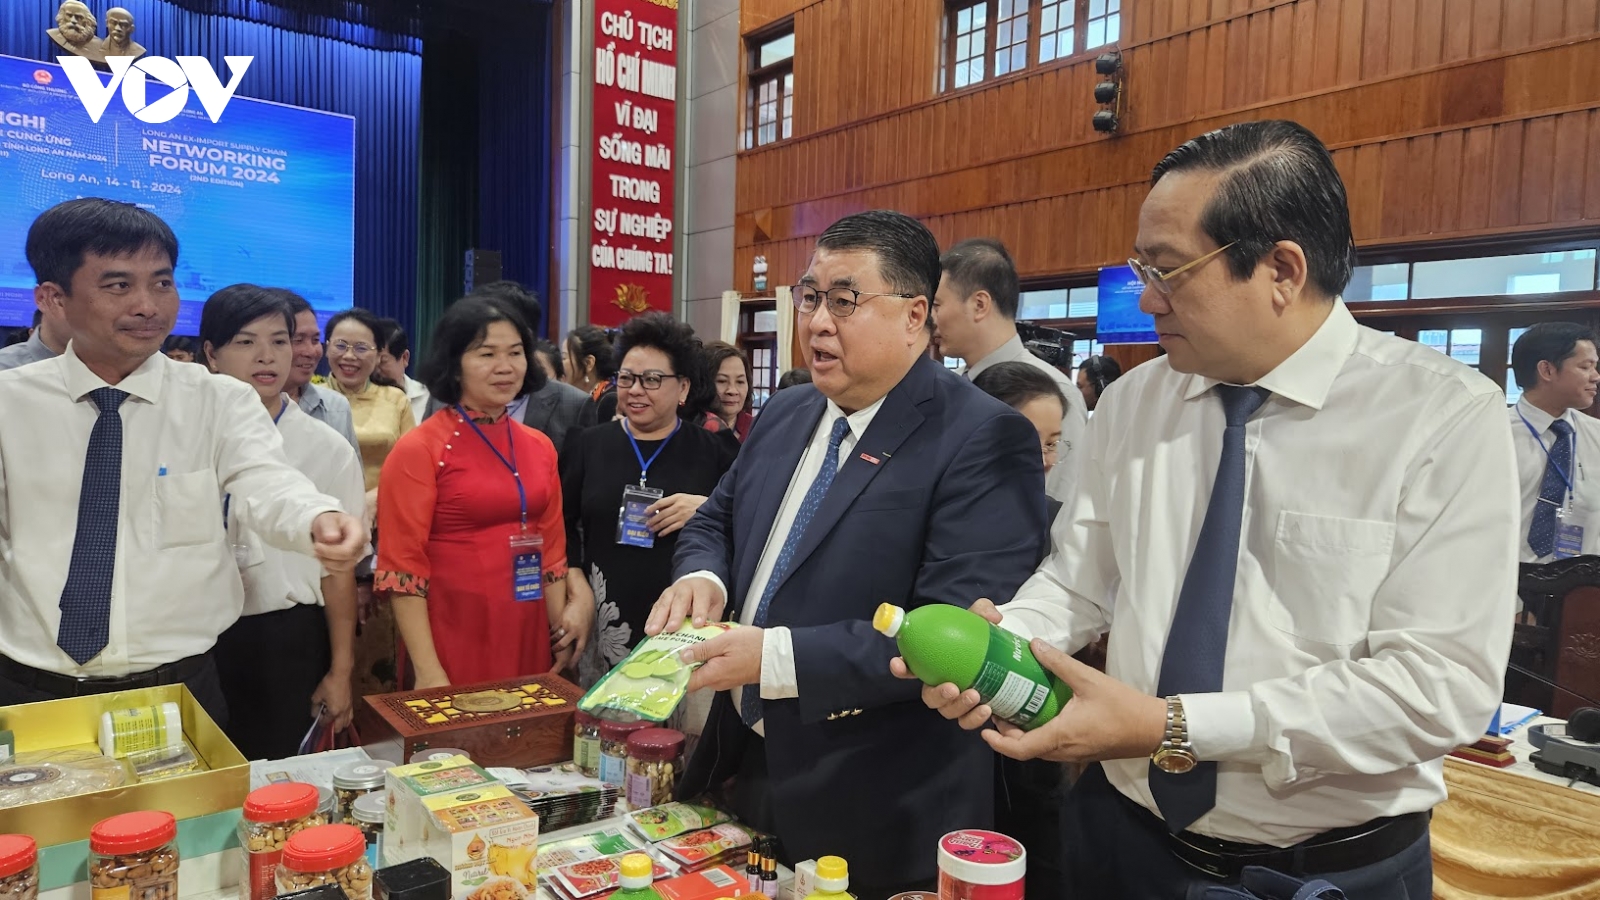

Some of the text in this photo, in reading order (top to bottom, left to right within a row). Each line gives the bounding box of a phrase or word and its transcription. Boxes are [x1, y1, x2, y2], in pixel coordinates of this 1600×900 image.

[601, 10, 673, 51] CHỦ TỊCH
[596, 41, 676, 101] HỒ CHÍ MINH
[614, 100, 658, 134] VĨ ĐẠI
[7, 130, 72, 147] CUNG ỨNG
[25, 145, 50, 154] LONG
[52, 148, 65, 156] AN
[87, 154, 108, 162] 2024
[142, 128, 287, 156] LONG AN EX-IMPORT SUPPLY CHAIN
[142, 137, 286, 170] NETWORKING
[599, 132, 671, 170] SỐNG MÃI
[42, 168, 75, 183] Long
[78, 173, 100, 186] An,
[105, 176, 120, 187] 14
[130, 179, 141, 188] 11
[151, 181, 182, 194] 2024
[149, 154, 280, 184] FORUM 2024
[609, 174, 661, 204] TRONG
[594, 208, 672, 242] SỰ NGHIỆP
[592, 238, 673, 275] CỦA CHÚNG TA!
